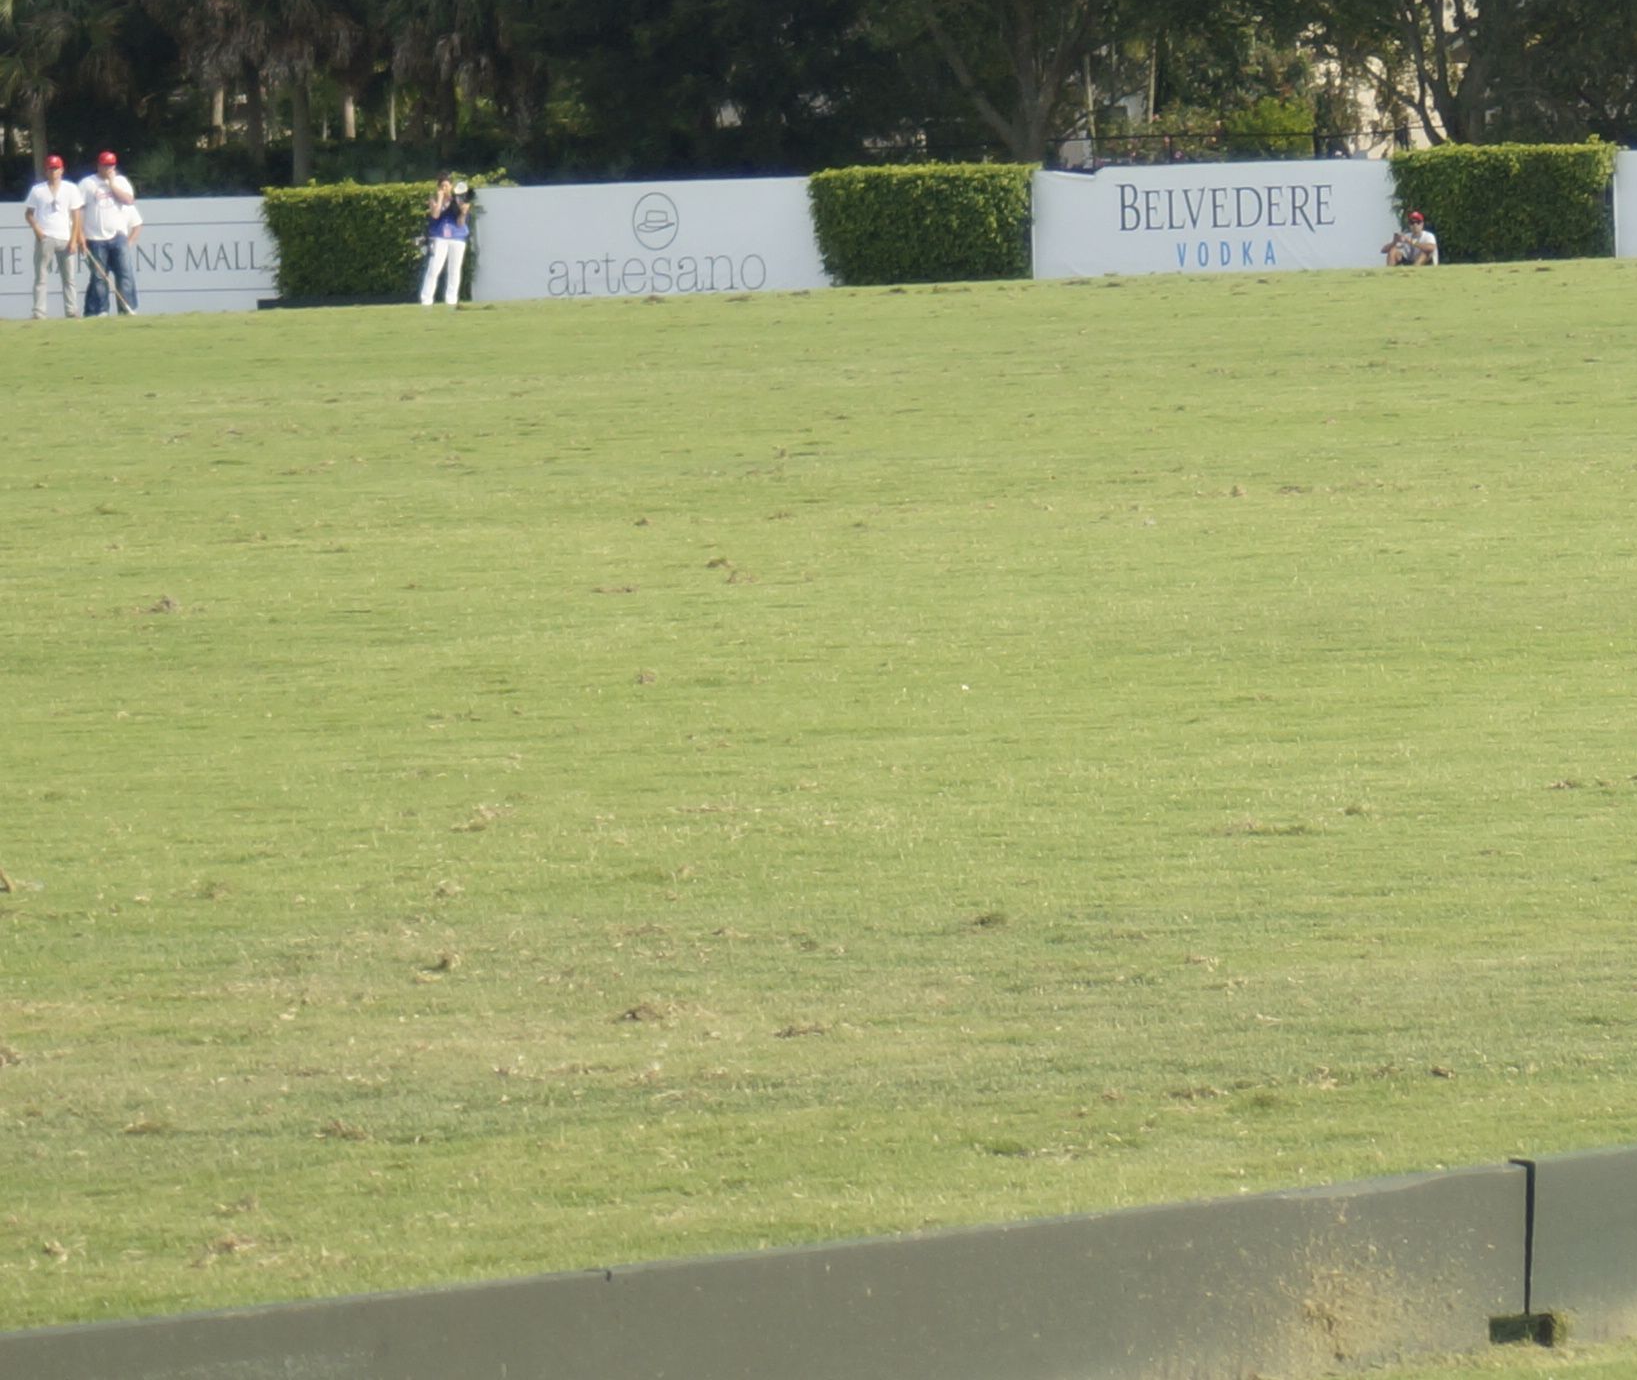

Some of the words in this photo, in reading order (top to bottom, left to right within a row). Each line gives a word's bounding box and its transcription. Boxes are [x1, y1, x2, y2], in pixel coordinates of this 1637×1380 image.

[1116, 184, 1335, 232] BELVEDERE
[185, 241, 267, 272] MALL
[1177, 239, 1276, 267] VODKA
[548, 253, 766, 295] artesano
